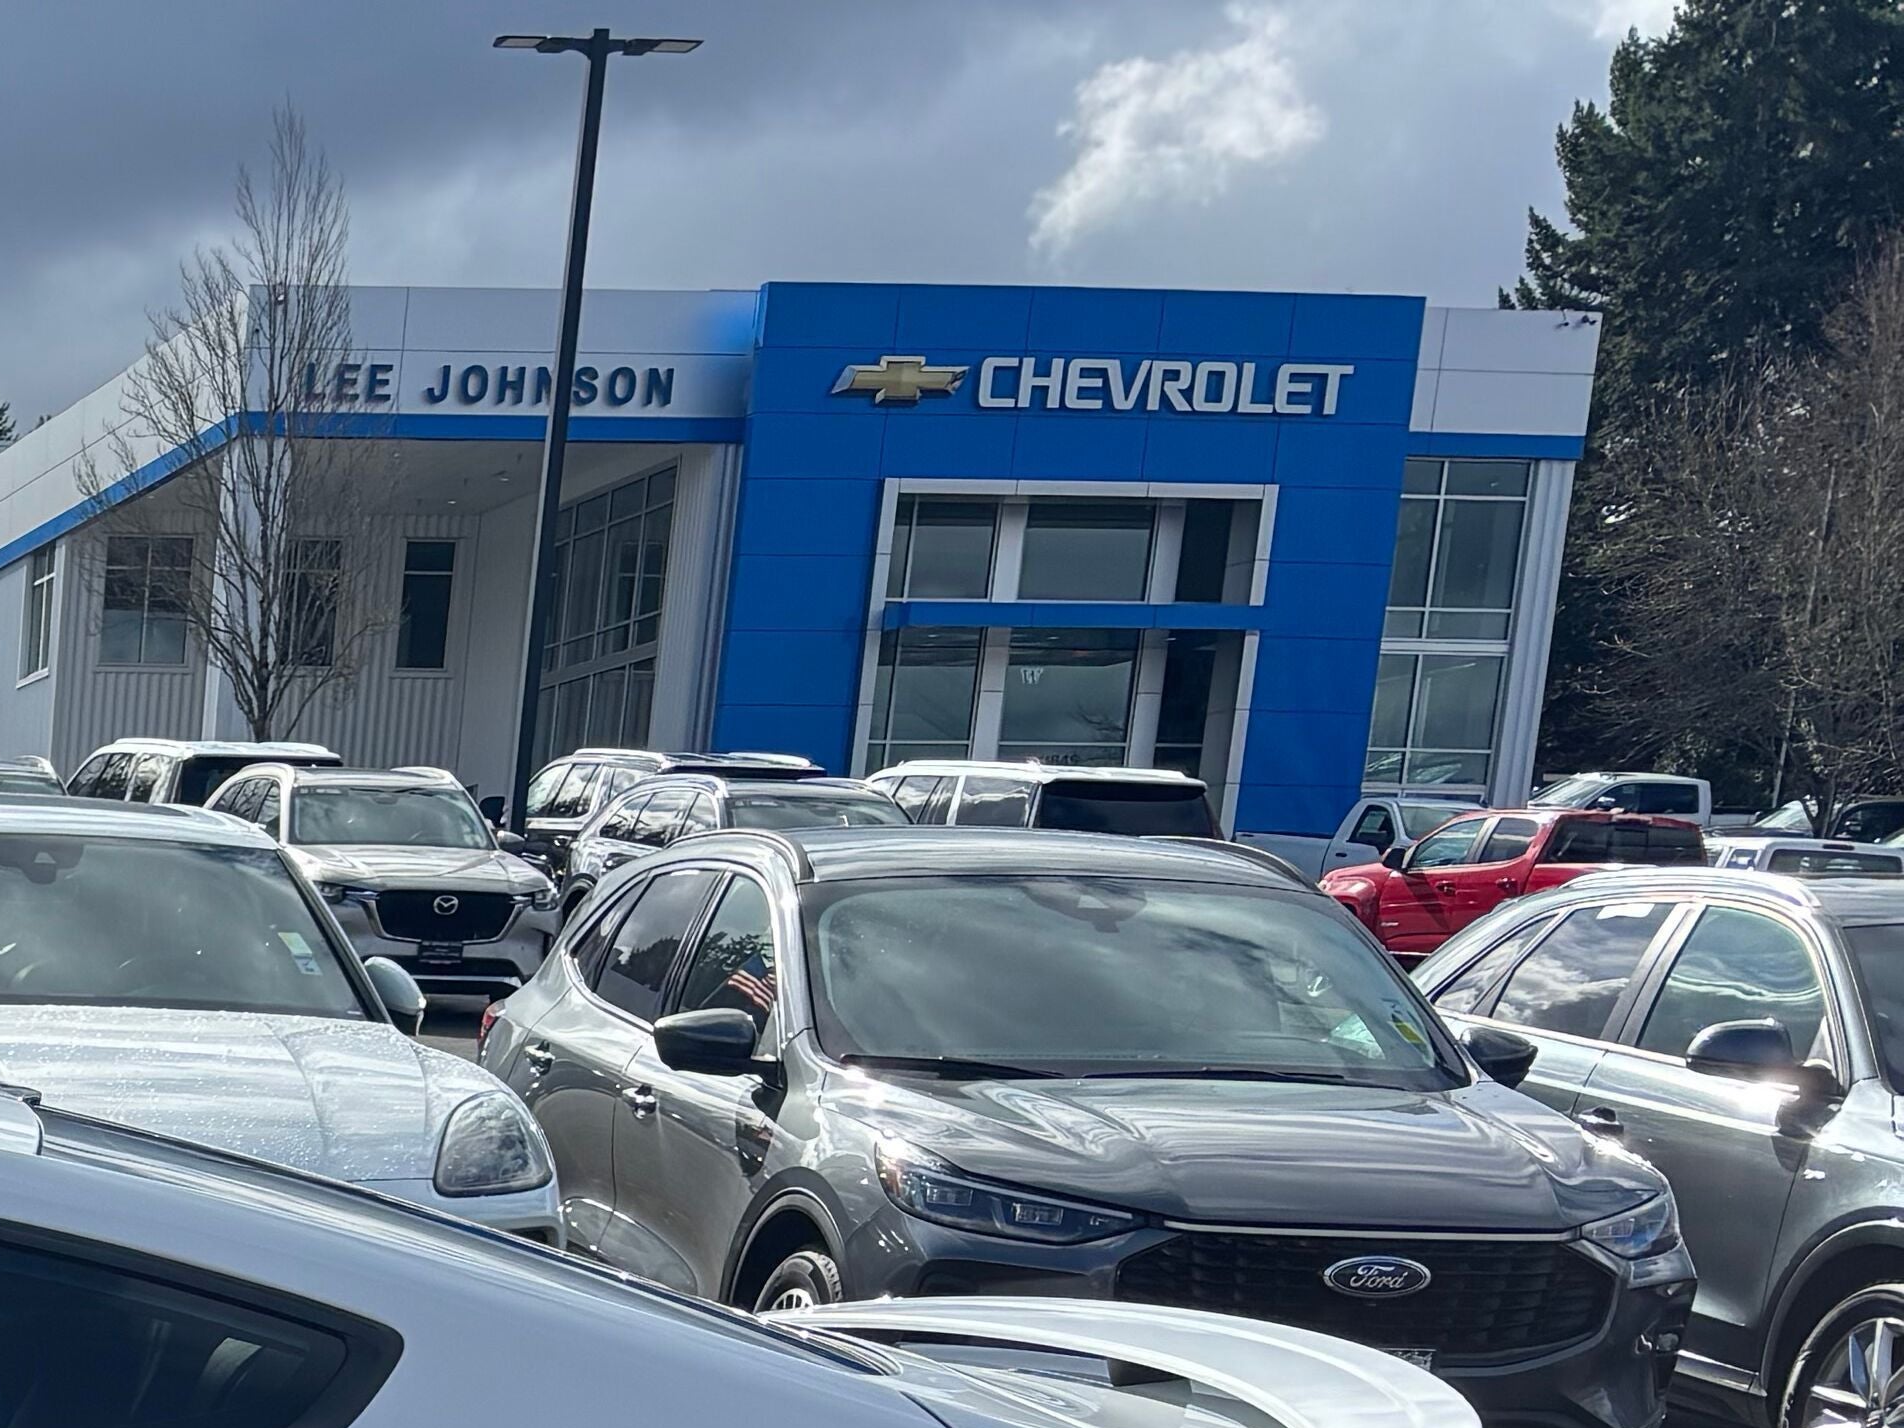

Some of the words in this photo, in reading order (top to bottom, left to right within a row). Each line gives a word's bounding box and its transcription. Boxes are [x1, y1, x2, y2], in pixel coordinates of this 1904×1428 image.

[305, 361, 394, 403] LEE
[978, 356, 1355, 416] CHEVROLET
[1349, 1263, 1409, 1289] Ford
